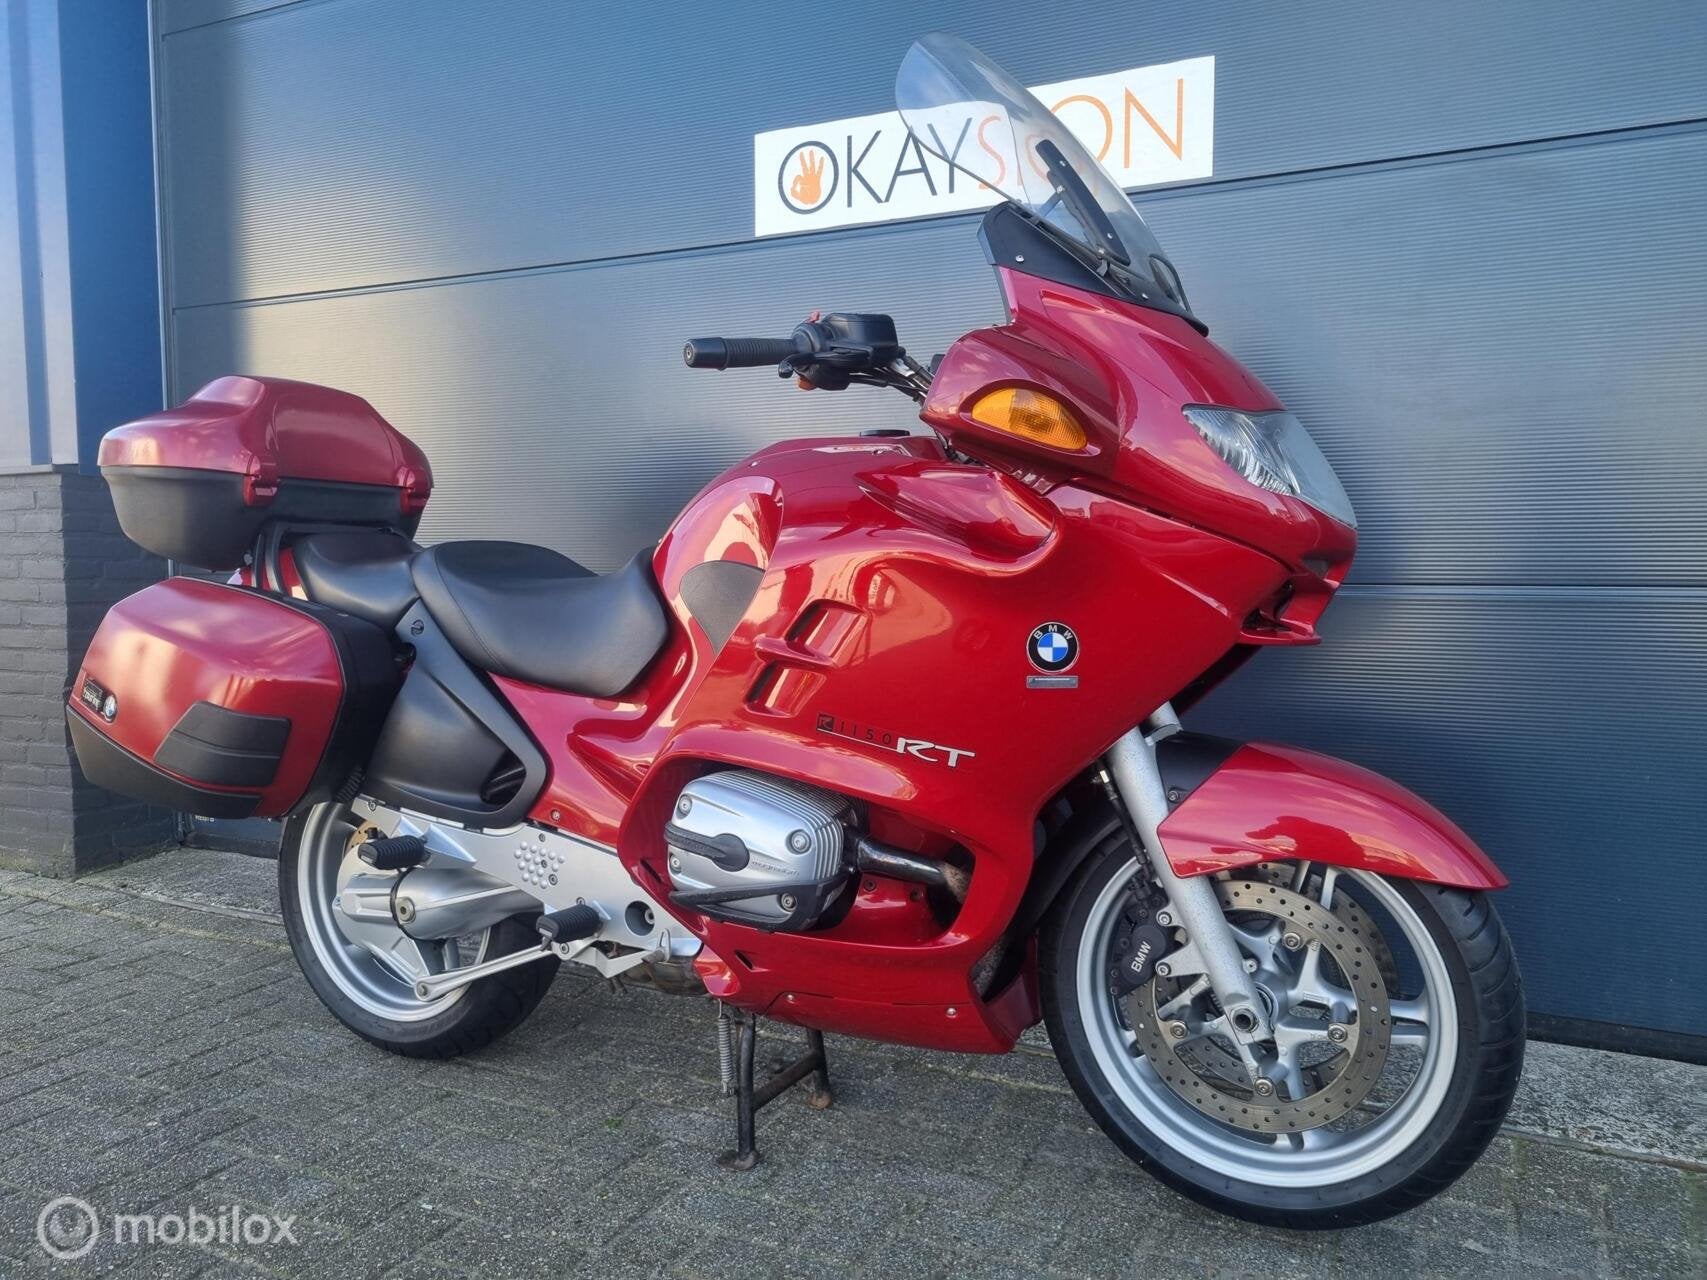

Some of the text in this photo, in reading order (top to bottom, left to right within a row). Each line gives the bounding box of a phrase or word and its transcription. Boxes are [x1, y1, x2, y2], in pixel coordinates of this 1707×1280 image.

[1033, 625, 1073, 640] BMW
[896, 737, 976, 768] RT
[1130, 940, 1151, 973] BMW
